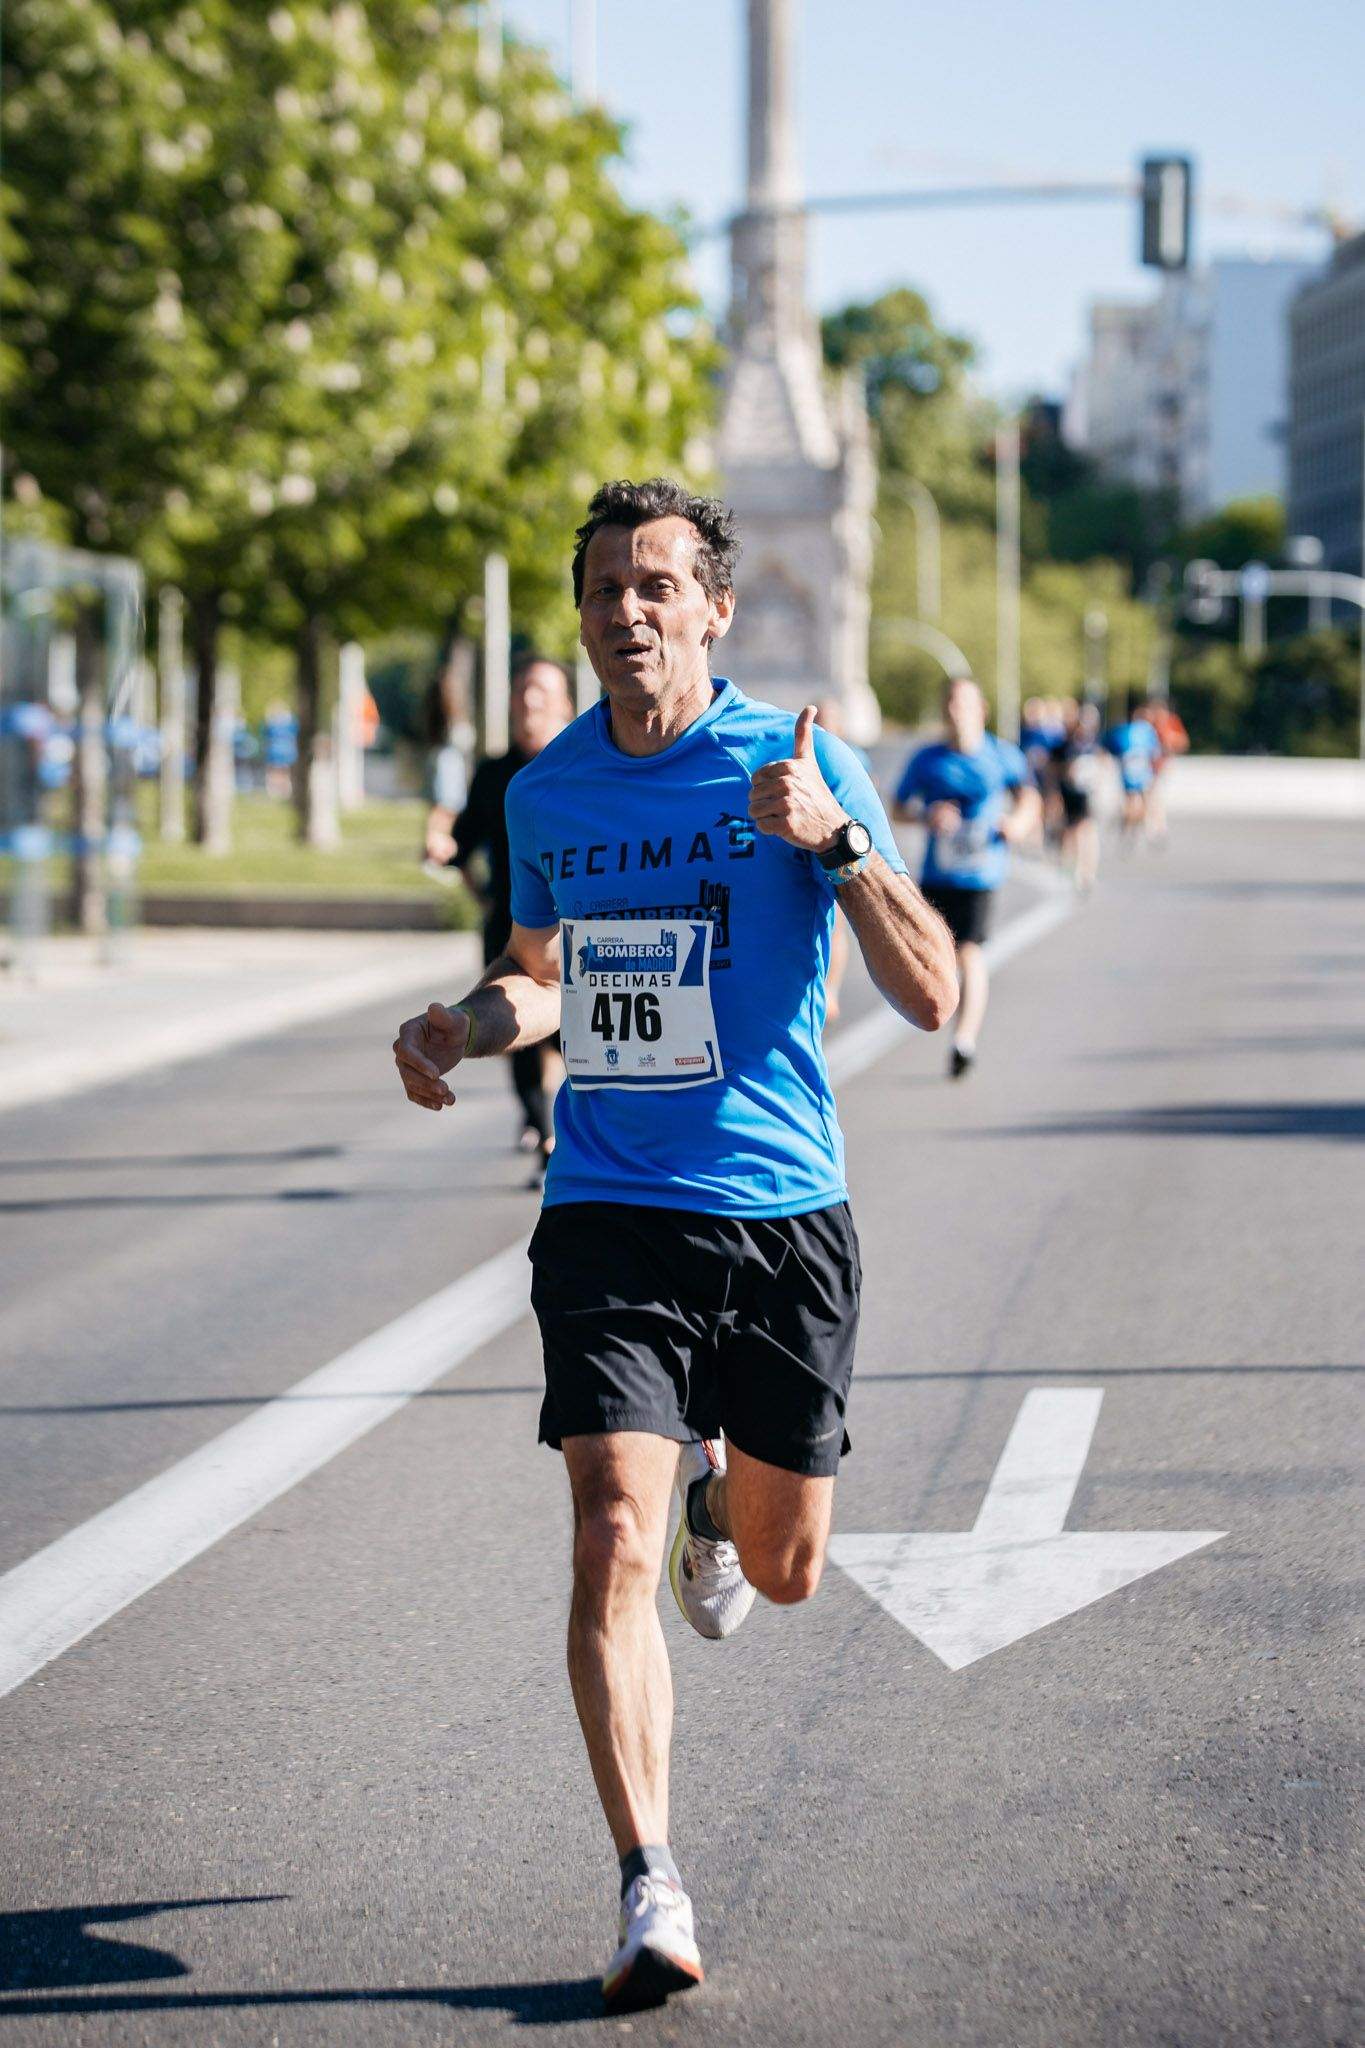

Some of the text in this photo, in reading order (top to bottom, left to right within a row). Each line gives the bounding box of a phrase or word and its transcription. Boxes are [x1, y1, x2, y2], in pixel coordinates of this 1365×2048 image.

[539, 826, 755, 883] DECIMAS
[597, 945, 674, 958] BOMBEROS
[626, 959, 673, 970] de MADRID
[589, 974, 671, 987] DECIMAS
[591, 992, 662, 1042] 476
